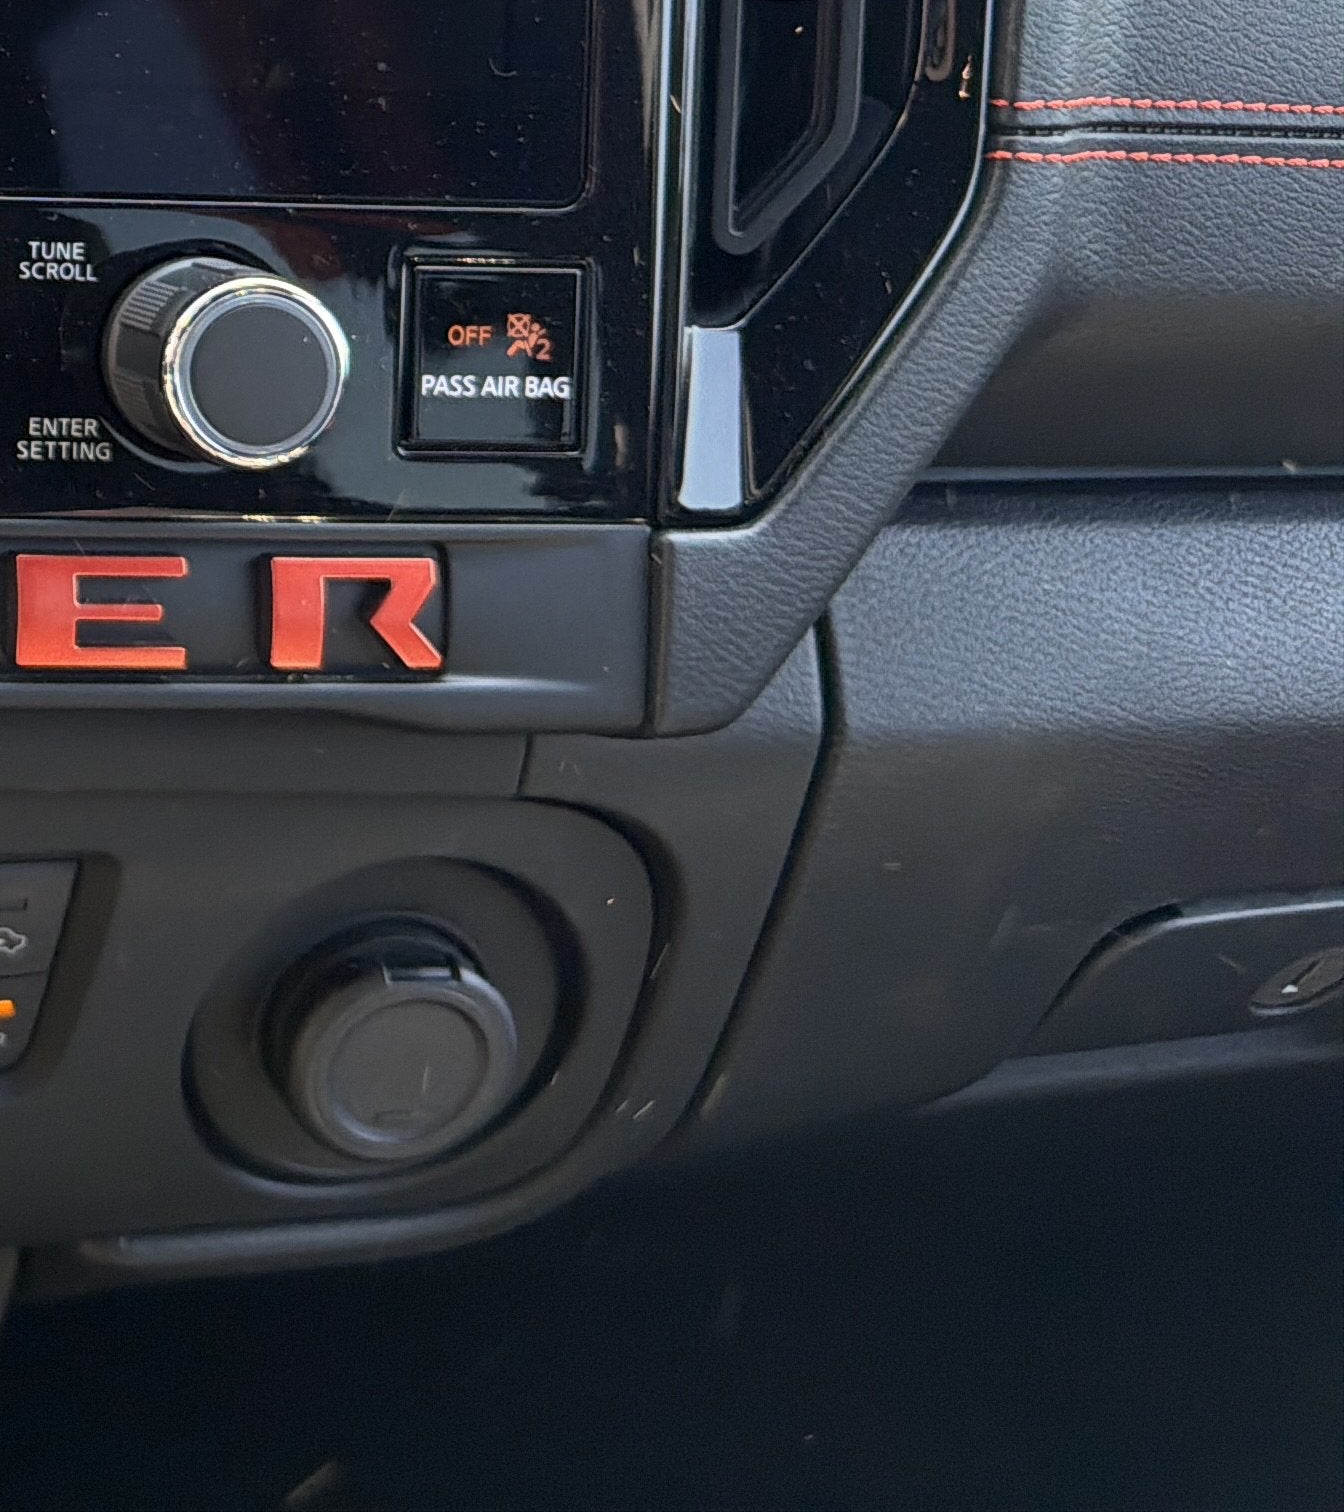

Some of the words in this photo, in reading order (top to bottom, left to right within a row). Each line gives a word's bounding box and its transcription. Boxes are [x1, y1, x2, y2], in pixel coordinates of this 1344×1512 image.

[28, 240, 85, 262] TUNE
[18, 261, 98, 283] SCROLL
[447, 324, 492, 348] OFF
[421, 373, 476, 398] PASS
[480, 373, 520, 398] AIR
[524, 374, 571, 400] BAG
[28, 416, 99, 440] ENTER
[16, 440, 112, 463] SETTING
